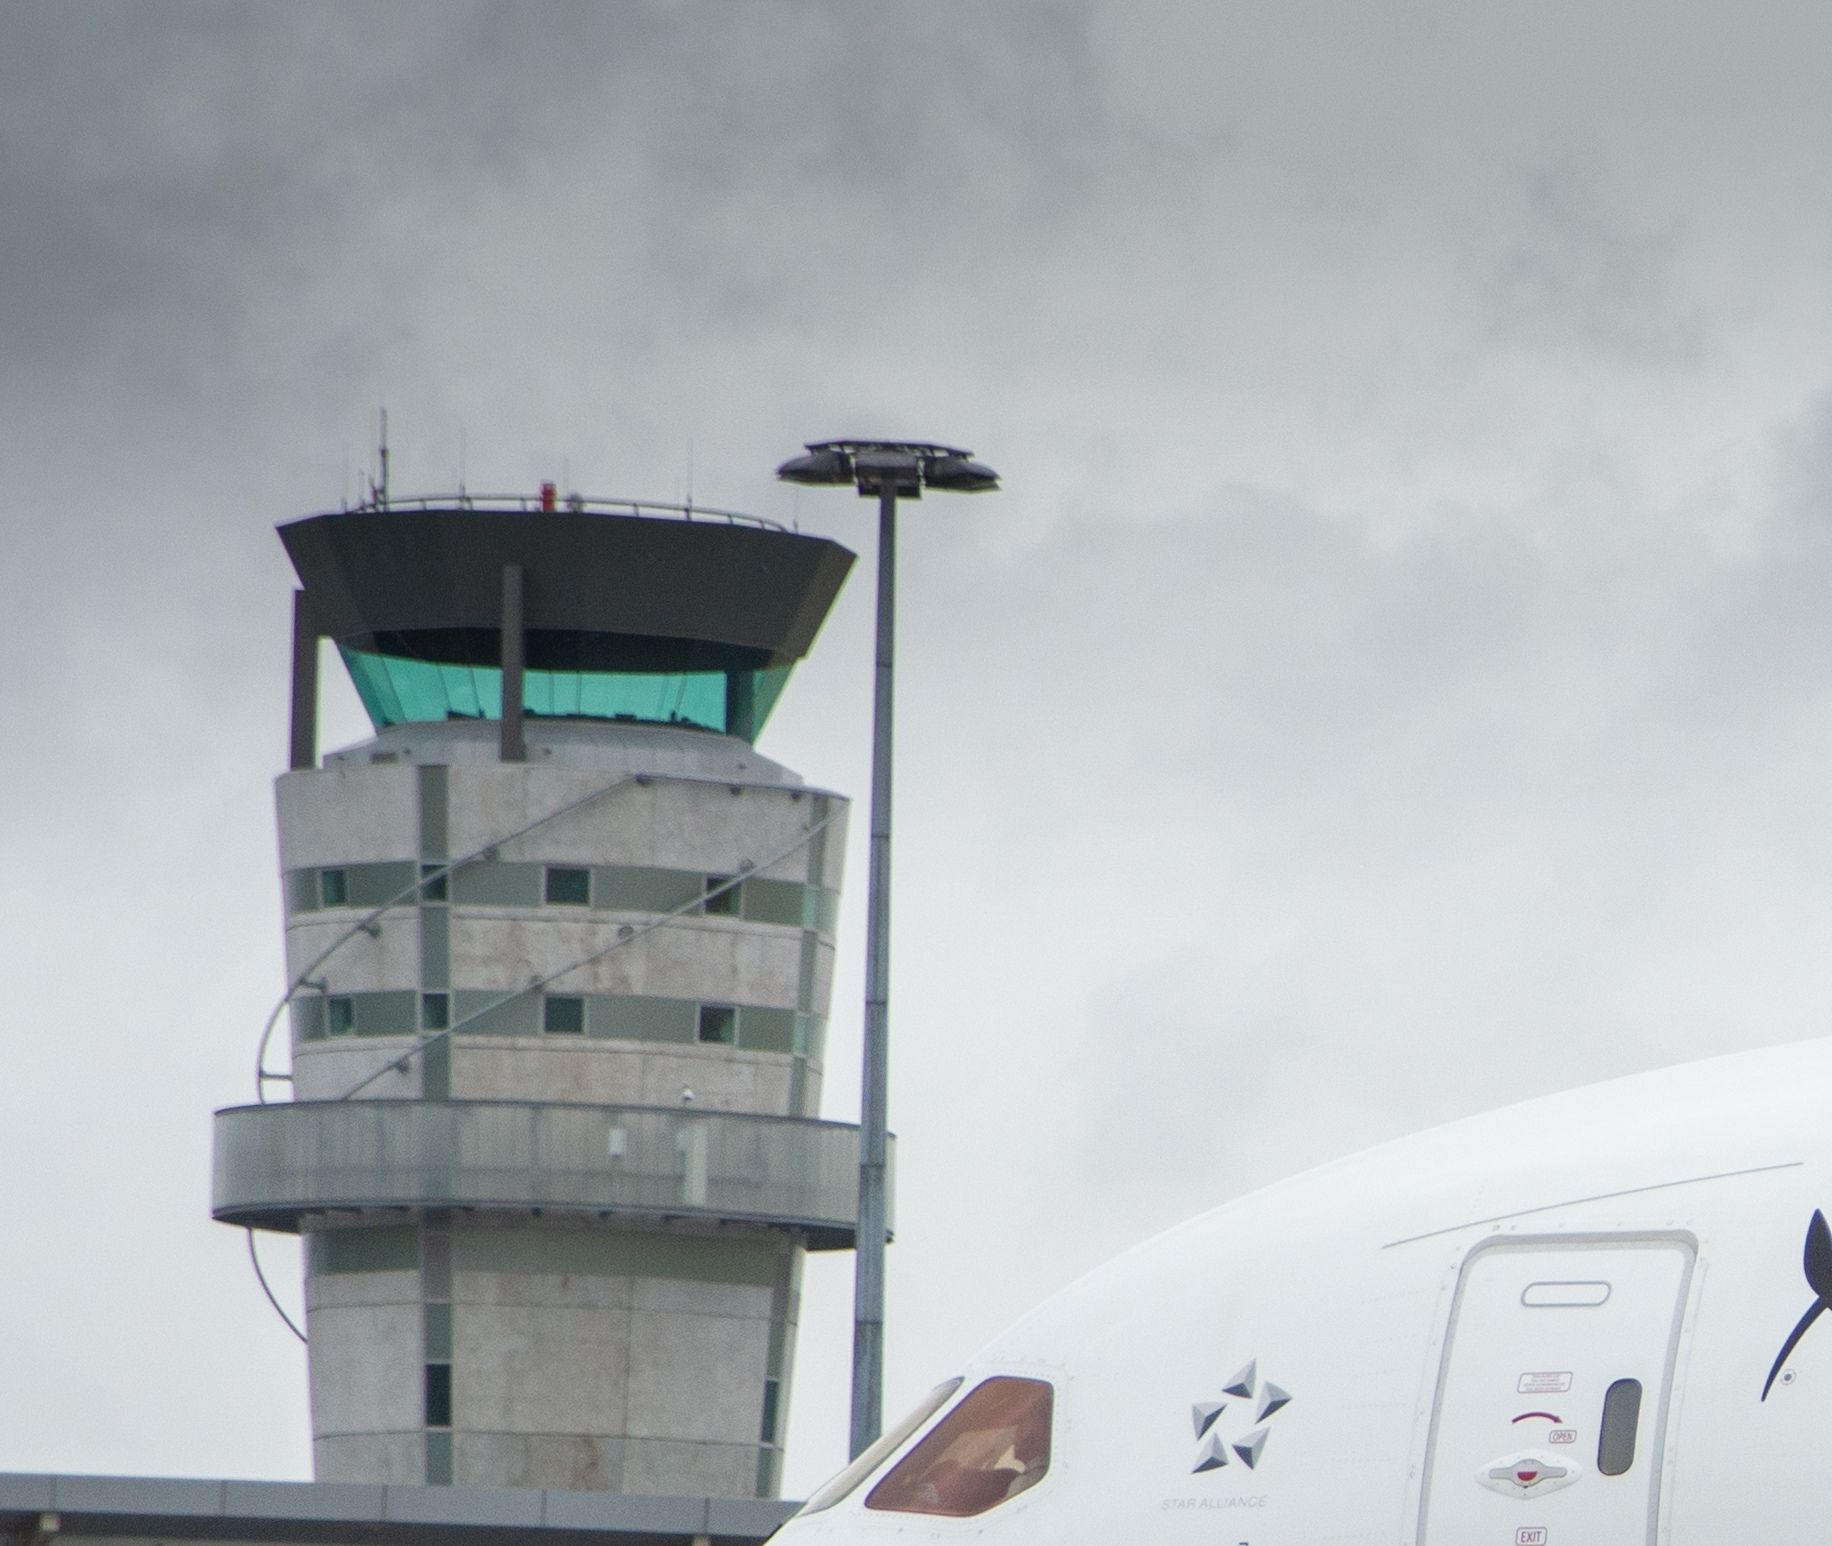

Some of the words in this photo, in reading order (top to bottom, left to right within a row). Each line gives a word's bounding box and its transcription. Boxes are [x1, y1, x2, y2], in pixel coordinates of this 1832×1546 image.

[1552, 1432, 1573, 1442] OPEN
[1161, 1498, 1196, 1511] STAR
[1199, 1495, 1268, 1509] ALLIANCE
[1520, 1531, 1542, 1543] EXIT
